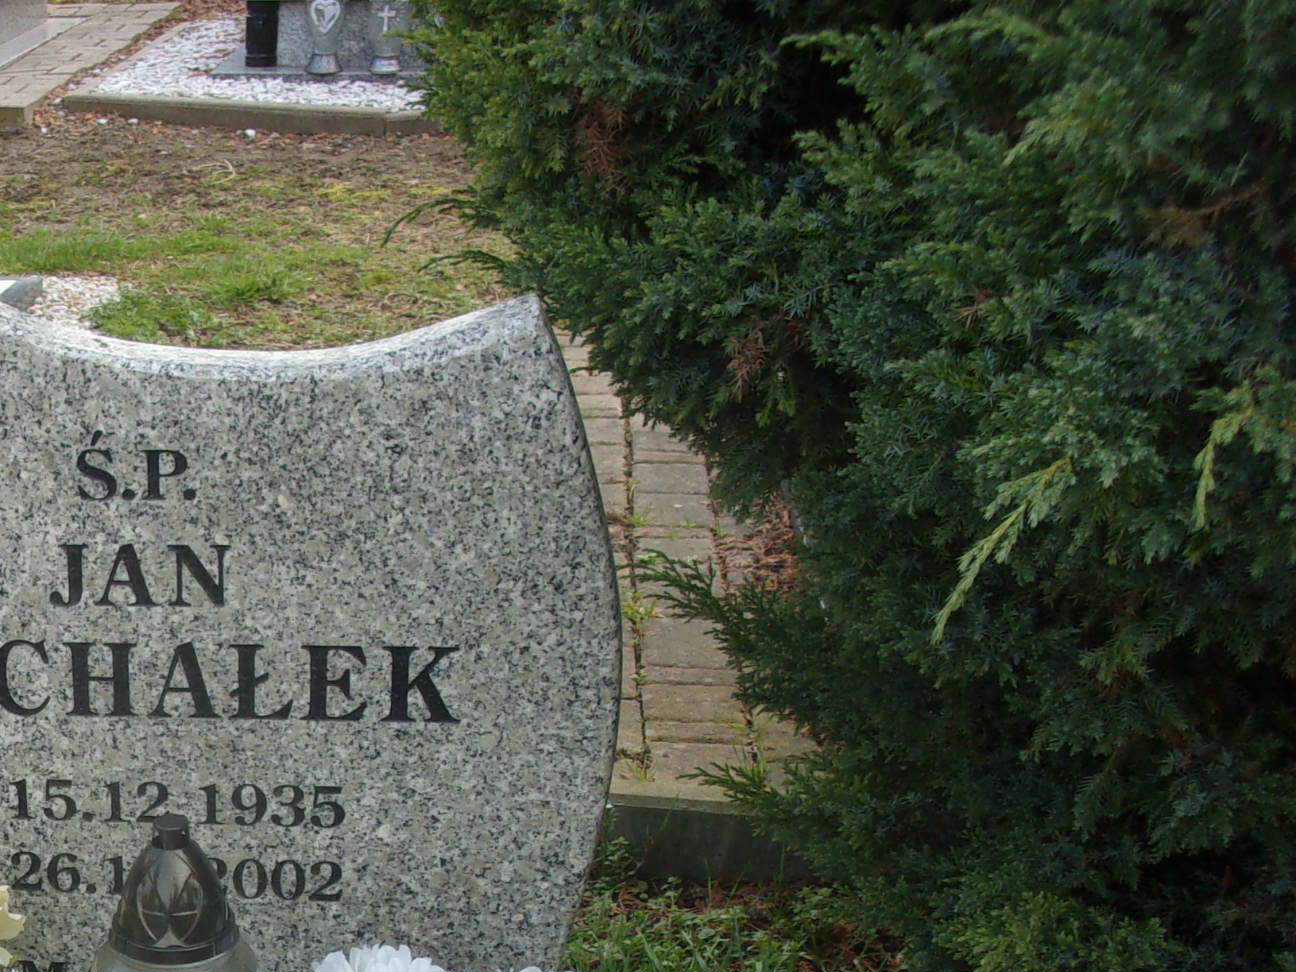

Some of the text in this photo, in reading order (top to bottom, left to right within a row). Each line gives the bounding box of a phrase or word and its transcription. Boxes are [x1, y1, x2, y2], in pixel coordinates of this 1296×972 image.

[77, 430, 197, 500] Ś.P.
[49, 542, 231, 607] JAN
[9, 778, 346, 828] 15.121935
